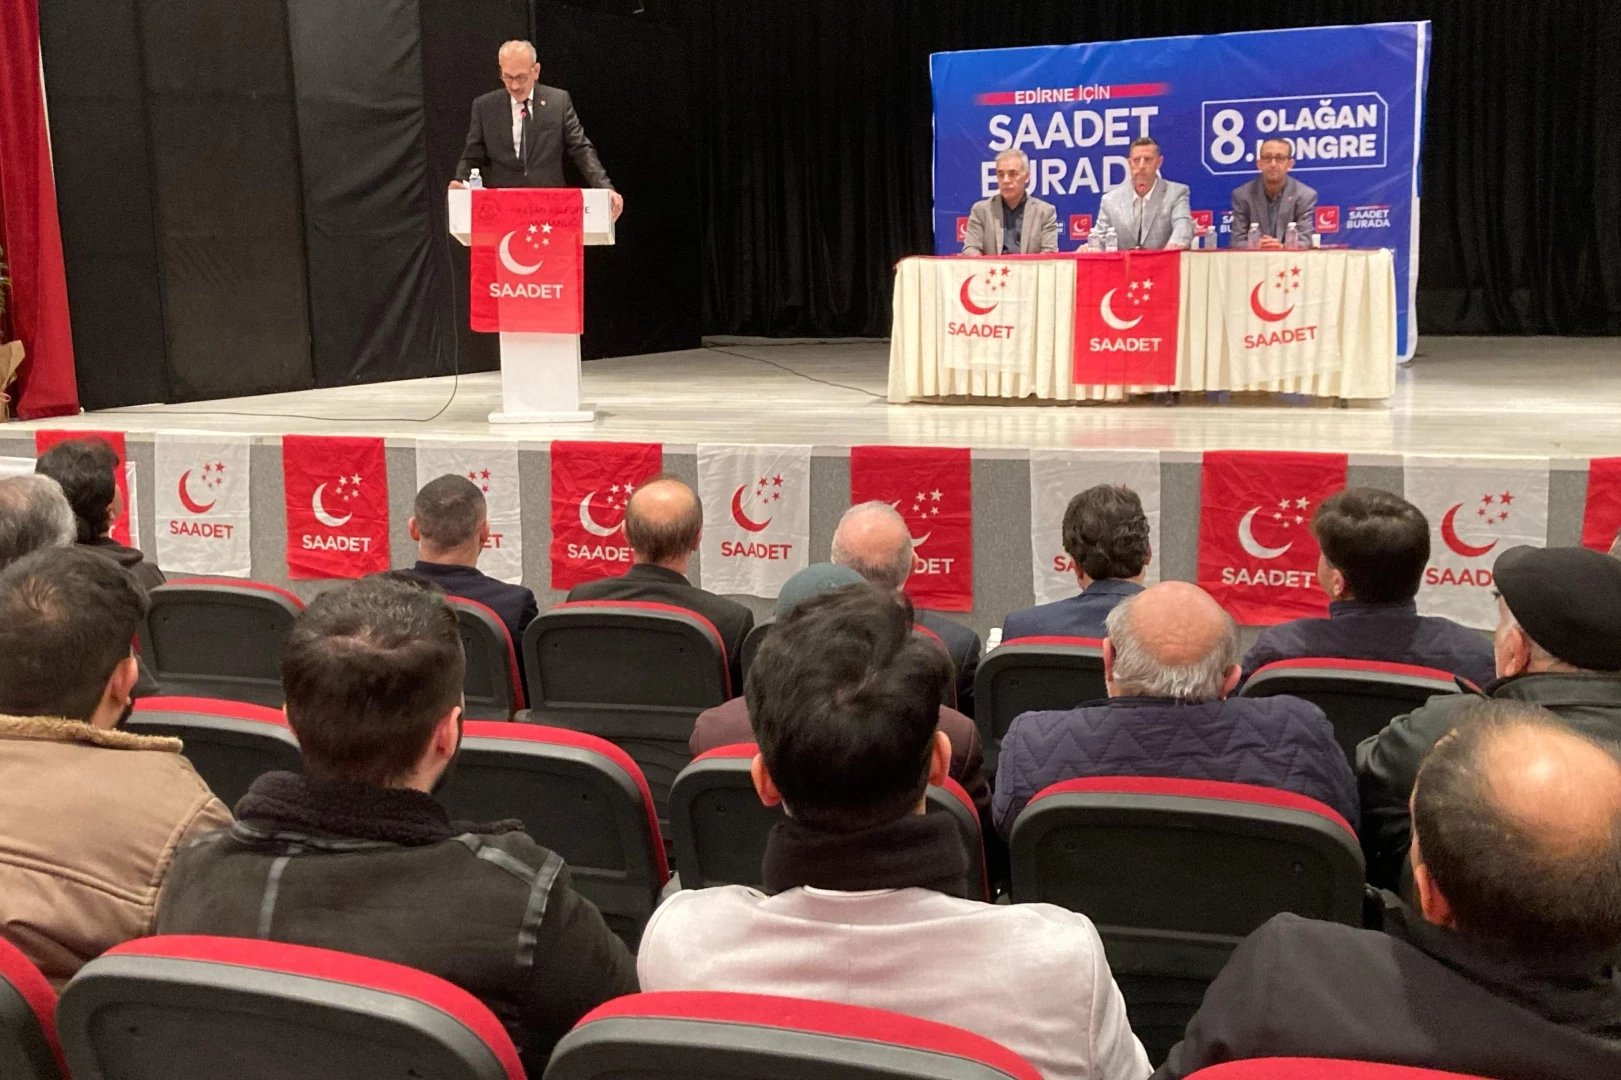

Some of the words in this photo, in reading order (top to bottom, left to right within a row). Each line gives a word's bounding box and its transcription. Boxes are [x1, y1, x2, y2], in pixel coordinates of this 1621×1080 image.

[1014, 87, 1074, 105] EDİRNE
[1079, 83, 1111, 104] İÇİN
[1256, 99, 1378, 133] OLAĞAN
[988, 106, 1159, 152] SAADET
[1211, 108, 1255, 165] 8.
[981, 153, 1162, 198] BURAD
[1346, 218, 1391, 229] BURADA
[1349, 209, 1390, 220] SAADET
[489, 282, 564, 300] SAADET
[948, 321, 1015, 340] SAADET
[1244, 325, 1318, 350] SAADET
[1089, 337, 1163, 352] SAADET
[169, 519, 233, 539] SAADET
[302, 534, 372, 553] SAADET
[567, 543, 635, 562] SAADE
[721, 540, 793, 560] SAADET
[1221, 566, 1317, 589] SAADET
